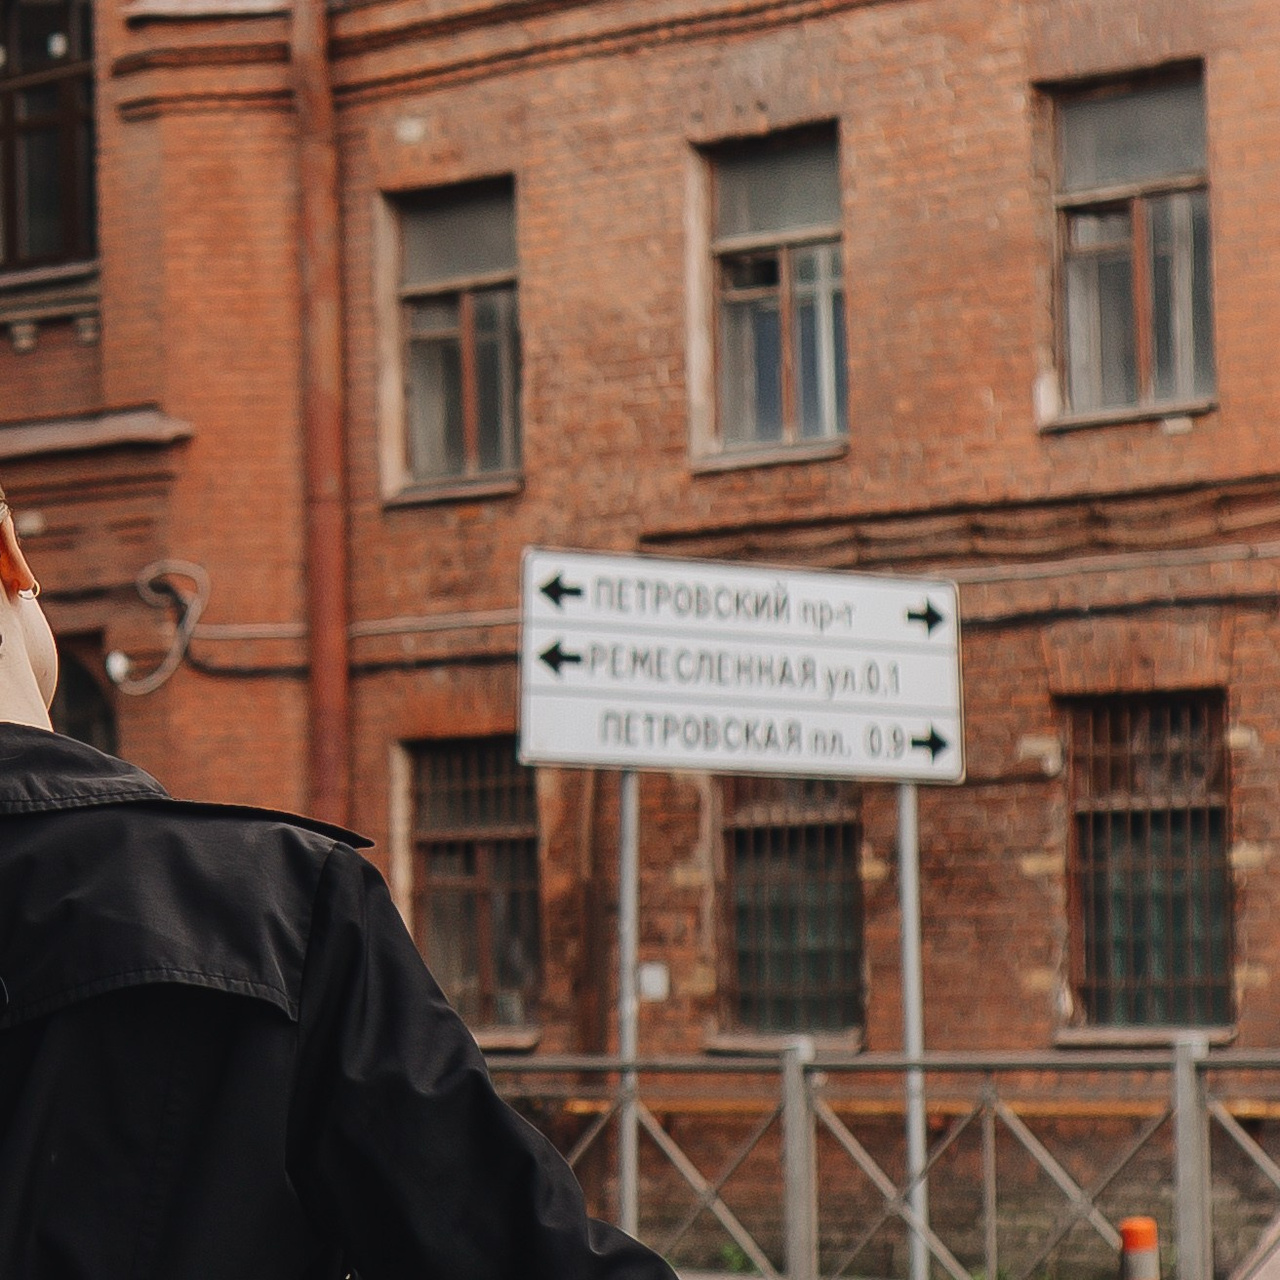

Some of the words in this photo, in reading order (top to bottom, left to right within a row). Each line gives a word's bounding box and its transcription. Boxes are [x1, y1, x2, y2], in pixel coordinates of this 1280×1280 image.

[595, 577, 791, 623] ПЕТРОВСКИЙ
[803, 600, 853, 633] пр-т
[589, 642, 817, 690] РЕМЕСЛЕННАЯ
[601, 710, 803, 754] ПЕТРОВСКАЯ
[812, 729, 852, 758] пл.
